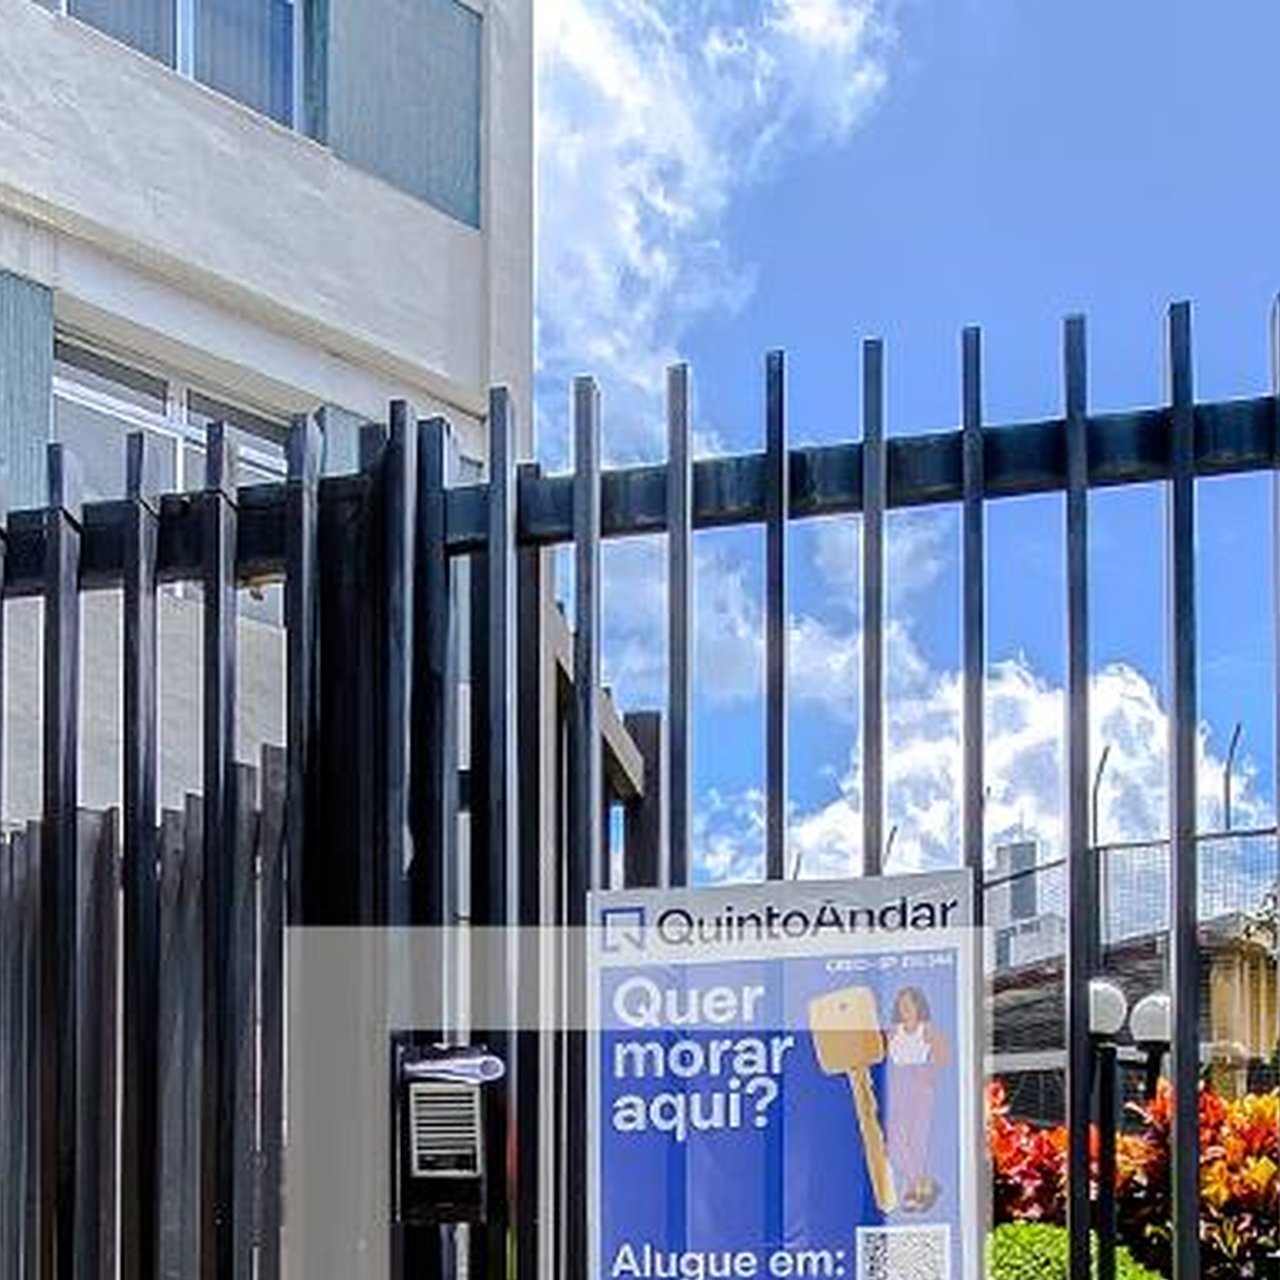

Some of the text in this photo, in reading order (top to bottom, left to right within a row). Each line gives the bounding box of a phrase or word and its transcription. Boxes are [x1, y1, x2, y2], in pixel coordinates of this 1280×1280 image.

[657, 898, 958, 946] QuintoAndar
[612, 976, 766, 1028] Quer
[613, 1034, 795, 1079] morar
[611, 1076, 779, 1142] aqui?
[769, 1250, 845, 1278] em:
